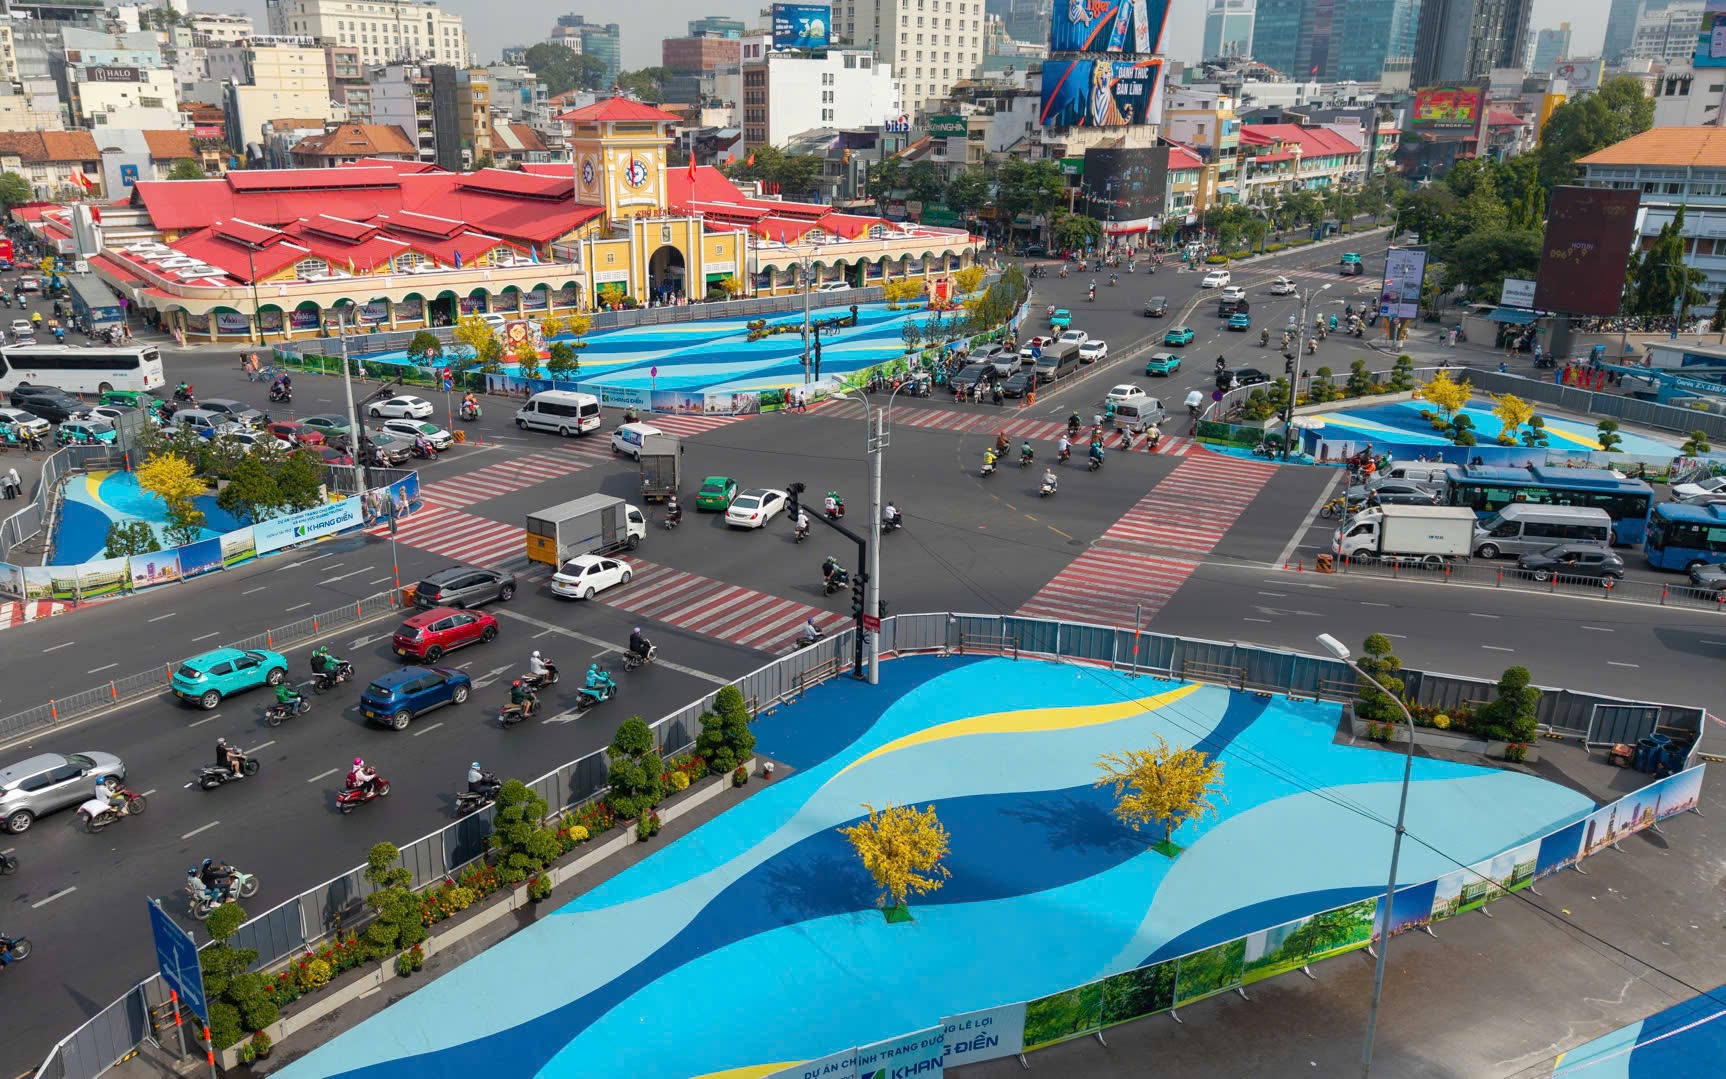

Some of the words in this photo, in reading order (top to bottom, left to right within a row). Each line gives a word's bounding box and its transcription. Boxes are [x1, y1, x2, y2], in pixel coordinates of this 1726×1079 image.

[307, 519, 336, 532] KHANG
[959, 1020, 972, 1031] LÊ
[975, 1017, 992, 1028] LỢI
[954, 1031, 999, 1054] ĐIỀN
[823, 1063, 839, 1075] ÁN
[880, 1043, 919, 1060] TRANG
